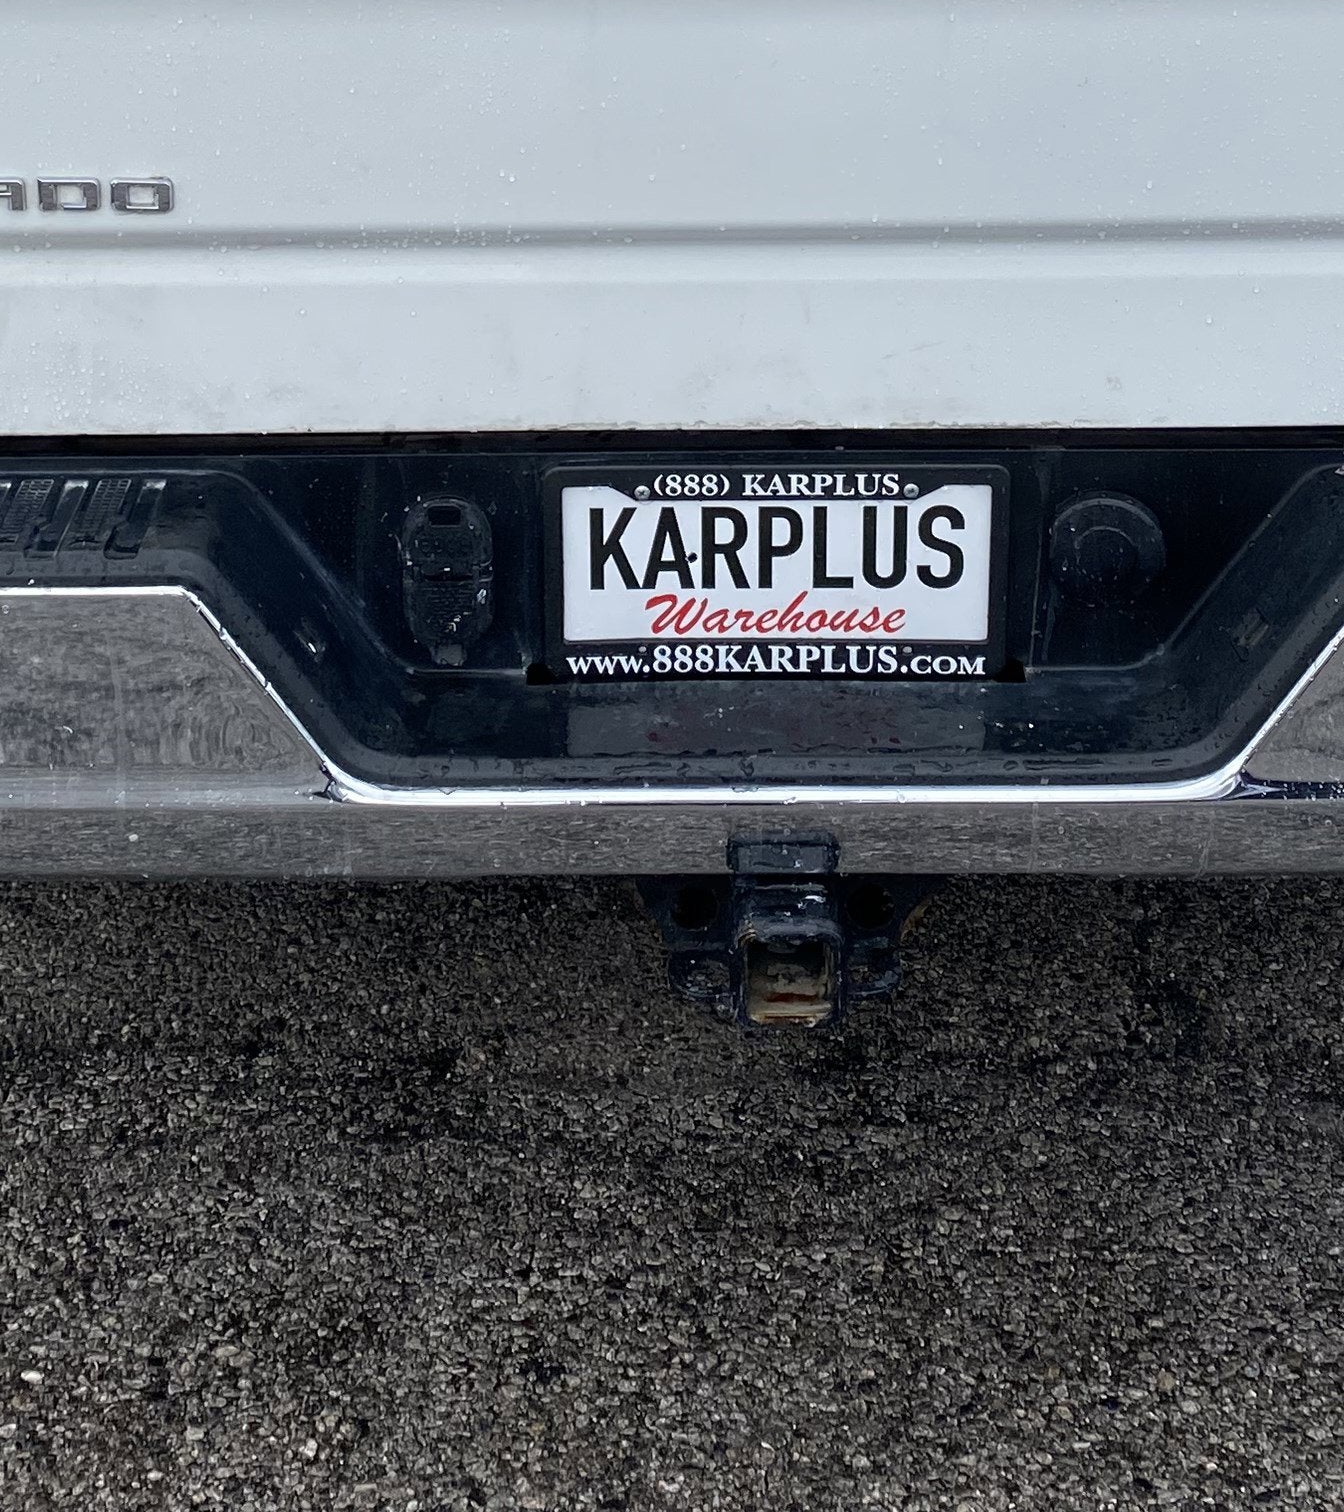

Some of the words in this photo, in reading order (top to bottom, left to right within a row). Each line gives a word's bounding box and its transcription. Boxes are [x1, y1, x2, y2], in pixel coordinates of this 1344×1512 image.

[654, 473, 730, 497] (888)
[742, 473, 900, 497] KARPLUS
[589, 504, 967, 591] KARPLUS
[645, 590, 906, 636] Warehouse
